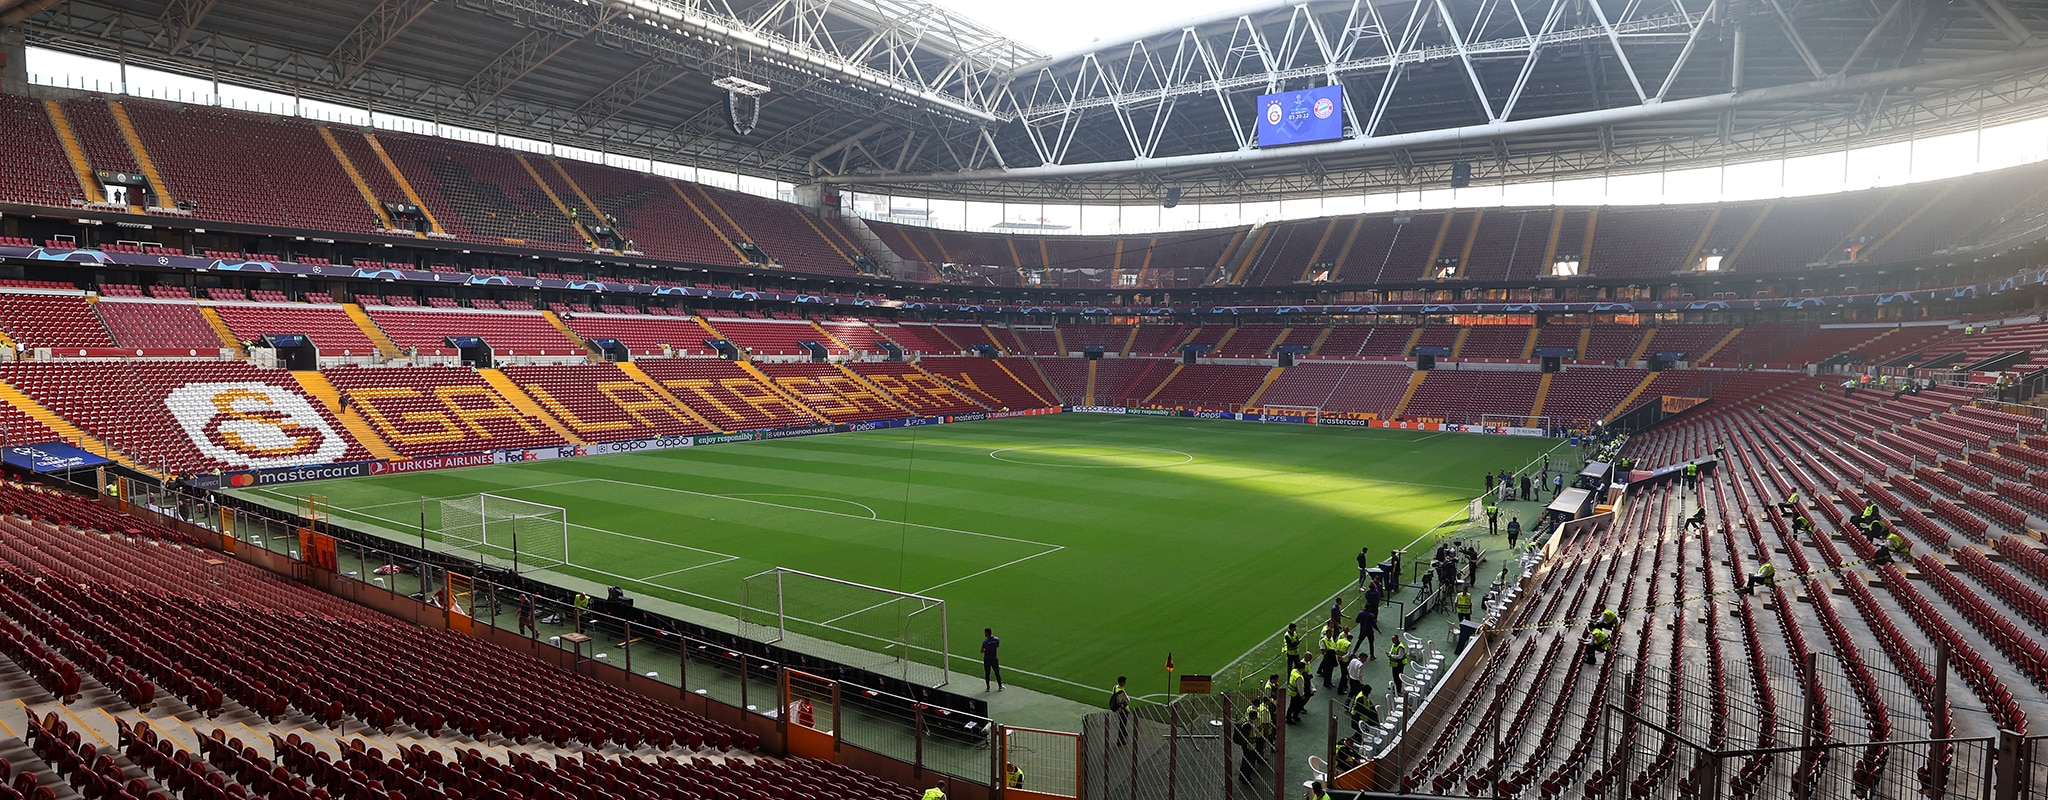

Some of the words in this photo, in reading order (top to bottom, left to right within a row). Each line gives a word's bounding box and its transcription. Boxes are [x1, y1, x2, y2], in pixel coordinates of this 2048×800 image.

[954, 413, 984, 421] mastercard
[1200, 411, 1220, 419] pepsi
[1319, 417, 1365, 426] mastercard
[786, 428, 811, 436] CHAMPIONS
[856, 423, 875, 431] pepsi
[1446, 423, 1469, 432] FedEx
[1484, 425, 1507, 434] FedEx
[656, 437, 689, 448] oppo
[698, 436, 716, 444] enjoy
[717, 432, 753, 443] responsibly
[612, 441, 647, 452] oppo
[505, 451, 537, 462] FedEx
[558, 446, 587, 458] FedEx
[390, 458, 442, 472] TURKISH
[445, 454, 494, 468] AIRLINES
[259, 464, 360, 484] mastercard
